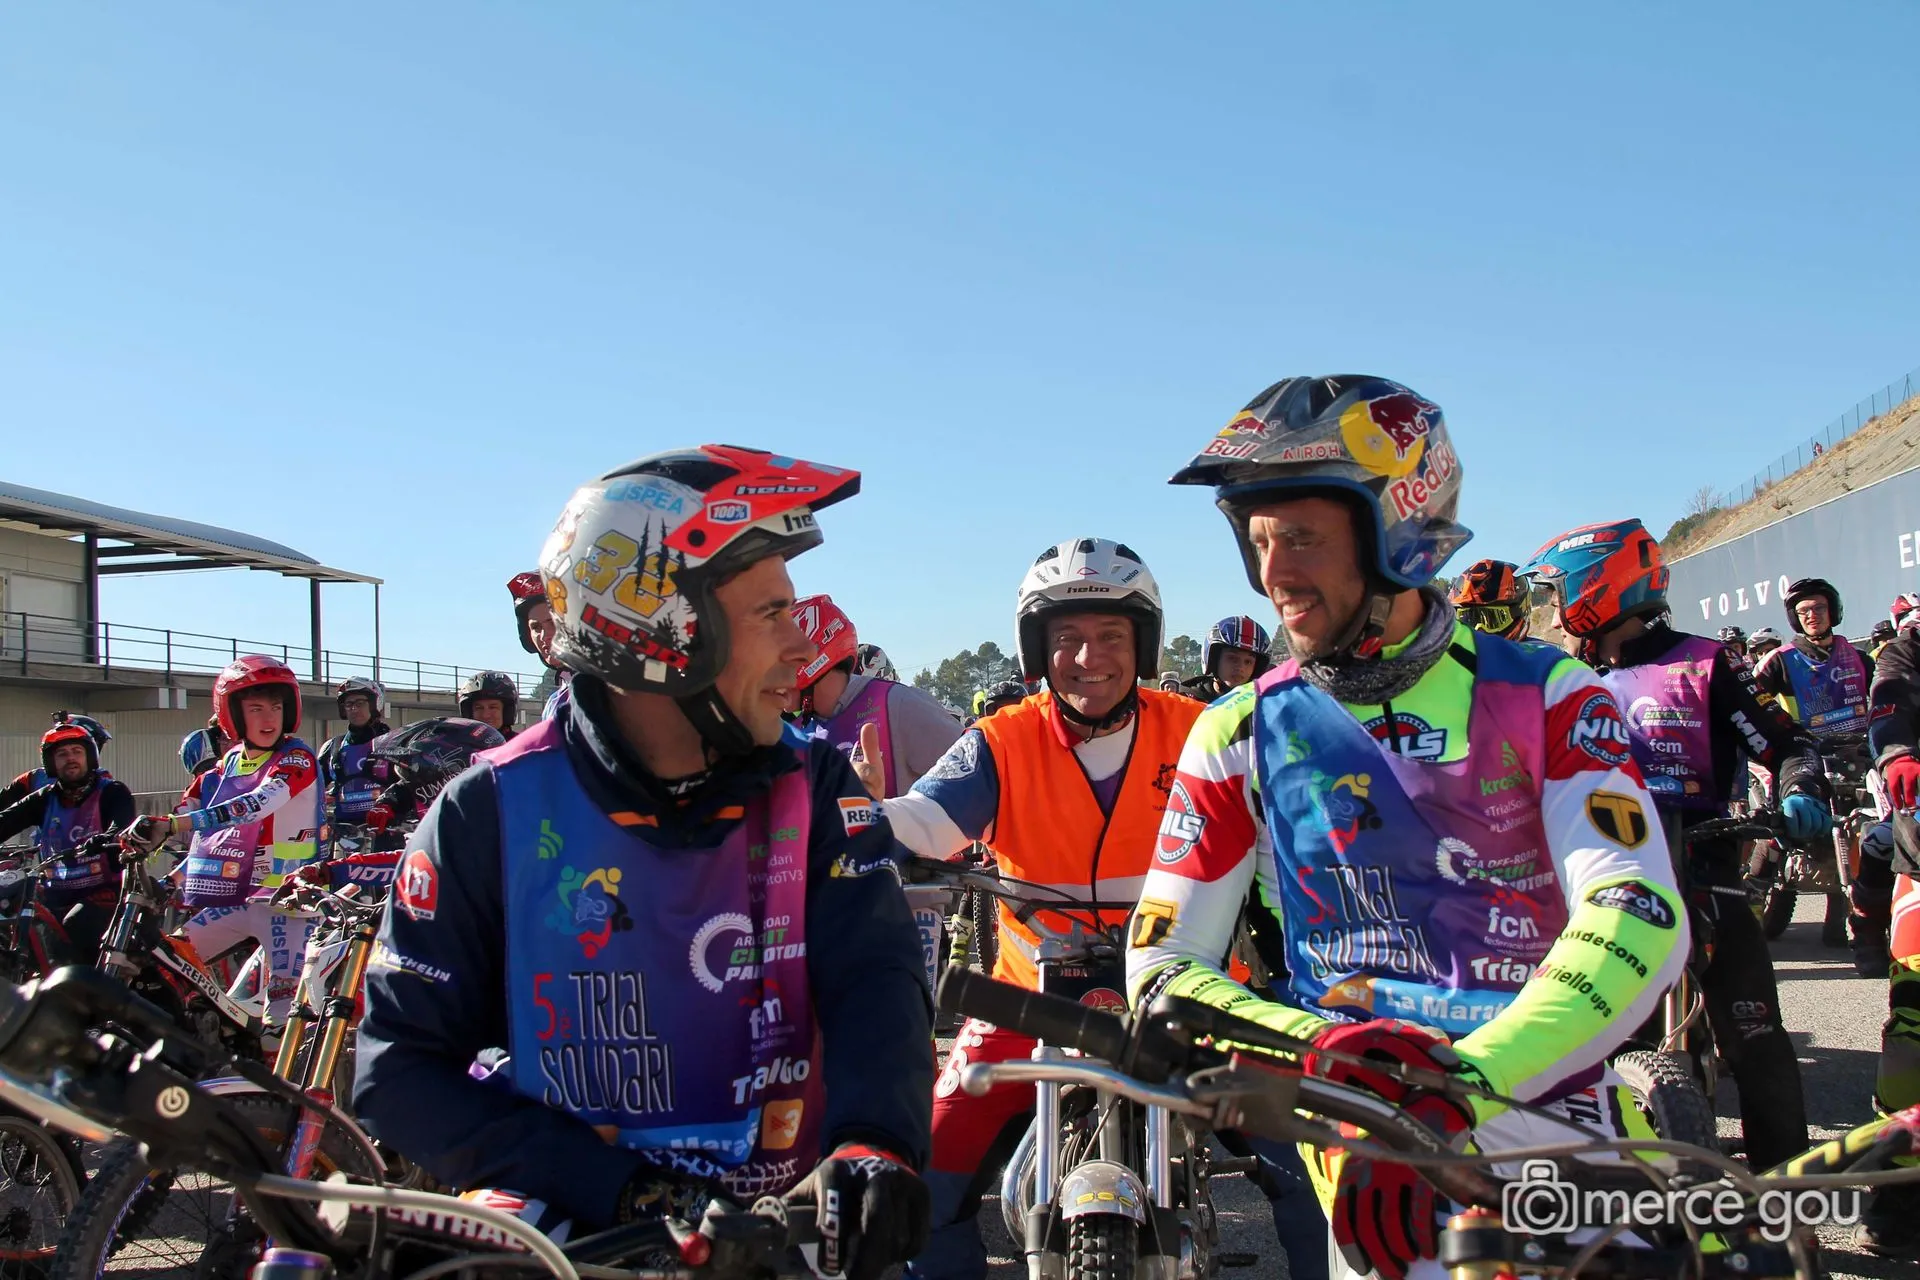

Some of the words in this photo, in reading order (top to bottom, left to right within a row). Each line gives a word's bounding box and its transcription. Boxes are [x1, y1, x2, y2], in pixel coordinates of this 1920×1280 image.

[1203, 438, 1260, 458] Bull
[1282, 445, 1340, 461] AIROH
[736, 485, 817, 496] hebo
[626, 483, 684, 515] SPEA
[712, 504, 747, 520] 100%
[1066, 585, 1110, 594] hebo
[1700, 574, 1790, 620] VOLVO
[1649, 738, 1683, 753] fcm
[208, 846, 246, 859] TrialGo
[1386, 986, 1416, 1011] La
[1590, 992, 1612, 1018] ups
